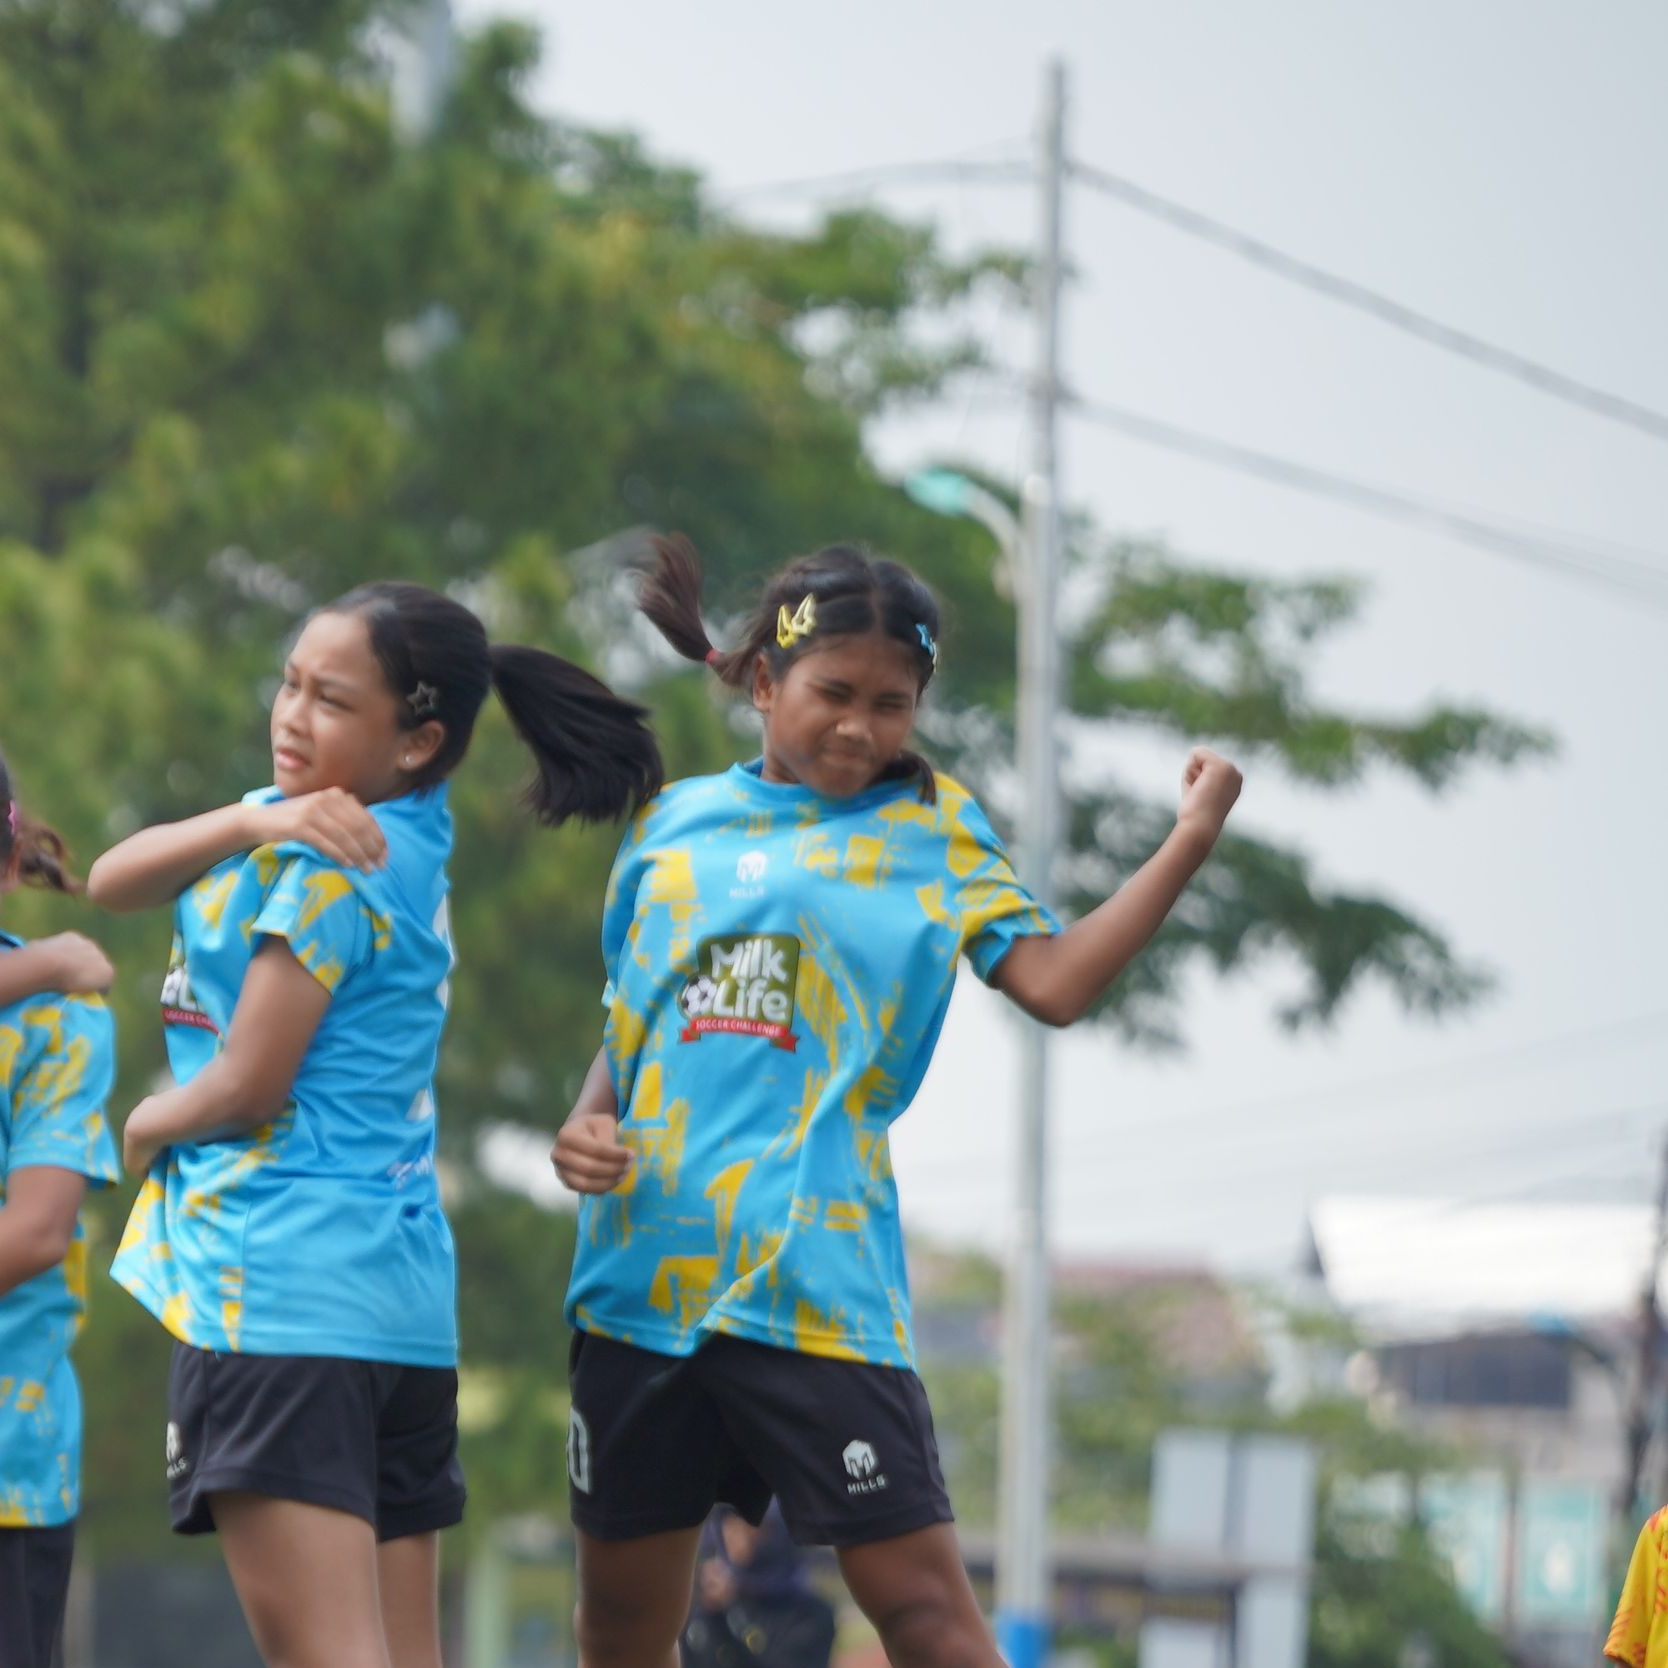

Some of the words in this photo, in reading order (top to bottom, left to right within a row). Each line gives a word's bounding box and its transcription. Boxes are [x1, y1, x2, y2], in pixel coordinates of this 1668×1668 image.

[710, 938, 788, 983] Milk
[712, 978, 787, 1022] Life
[696, 1019, 729, 1031] SOCCER
